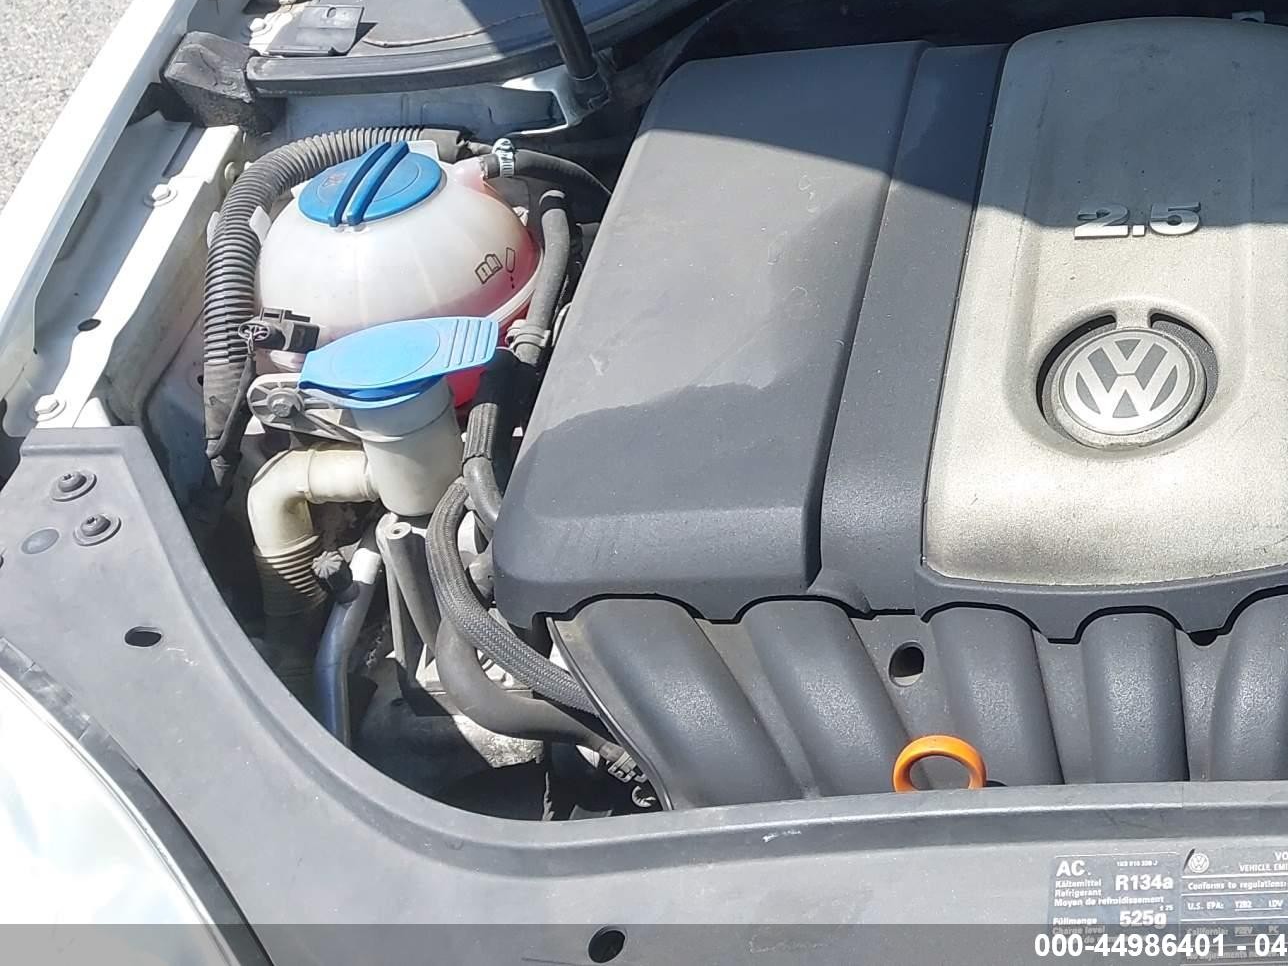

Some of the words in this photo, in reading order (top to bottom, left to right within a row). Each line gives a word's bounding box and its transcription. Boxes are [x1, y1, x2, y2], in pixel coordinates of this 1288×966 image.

[1074, 201, 1200, 240] 2.5
[1239, 863, 1272, 872] VEHICLE
[1055, 878, 1102, 888] Kältemittel
[1115, 873, 1174, 891] R134a
[1187, 881, 1224, 891] Conforms
[1228, 881, 1237, 889] to
[1054, 888, 1102, 899] Refrigerant
[1054, 898, 1083, 908] Moyen
[1085, 897, 1096, 906] de
[1098, 895, 1164, 905] refroidissement
[1187, 902, 1204, 910] U.S.
[1206, 900, 1224, 909] EPA:
[1120, 910, 1168, 930] 525g
